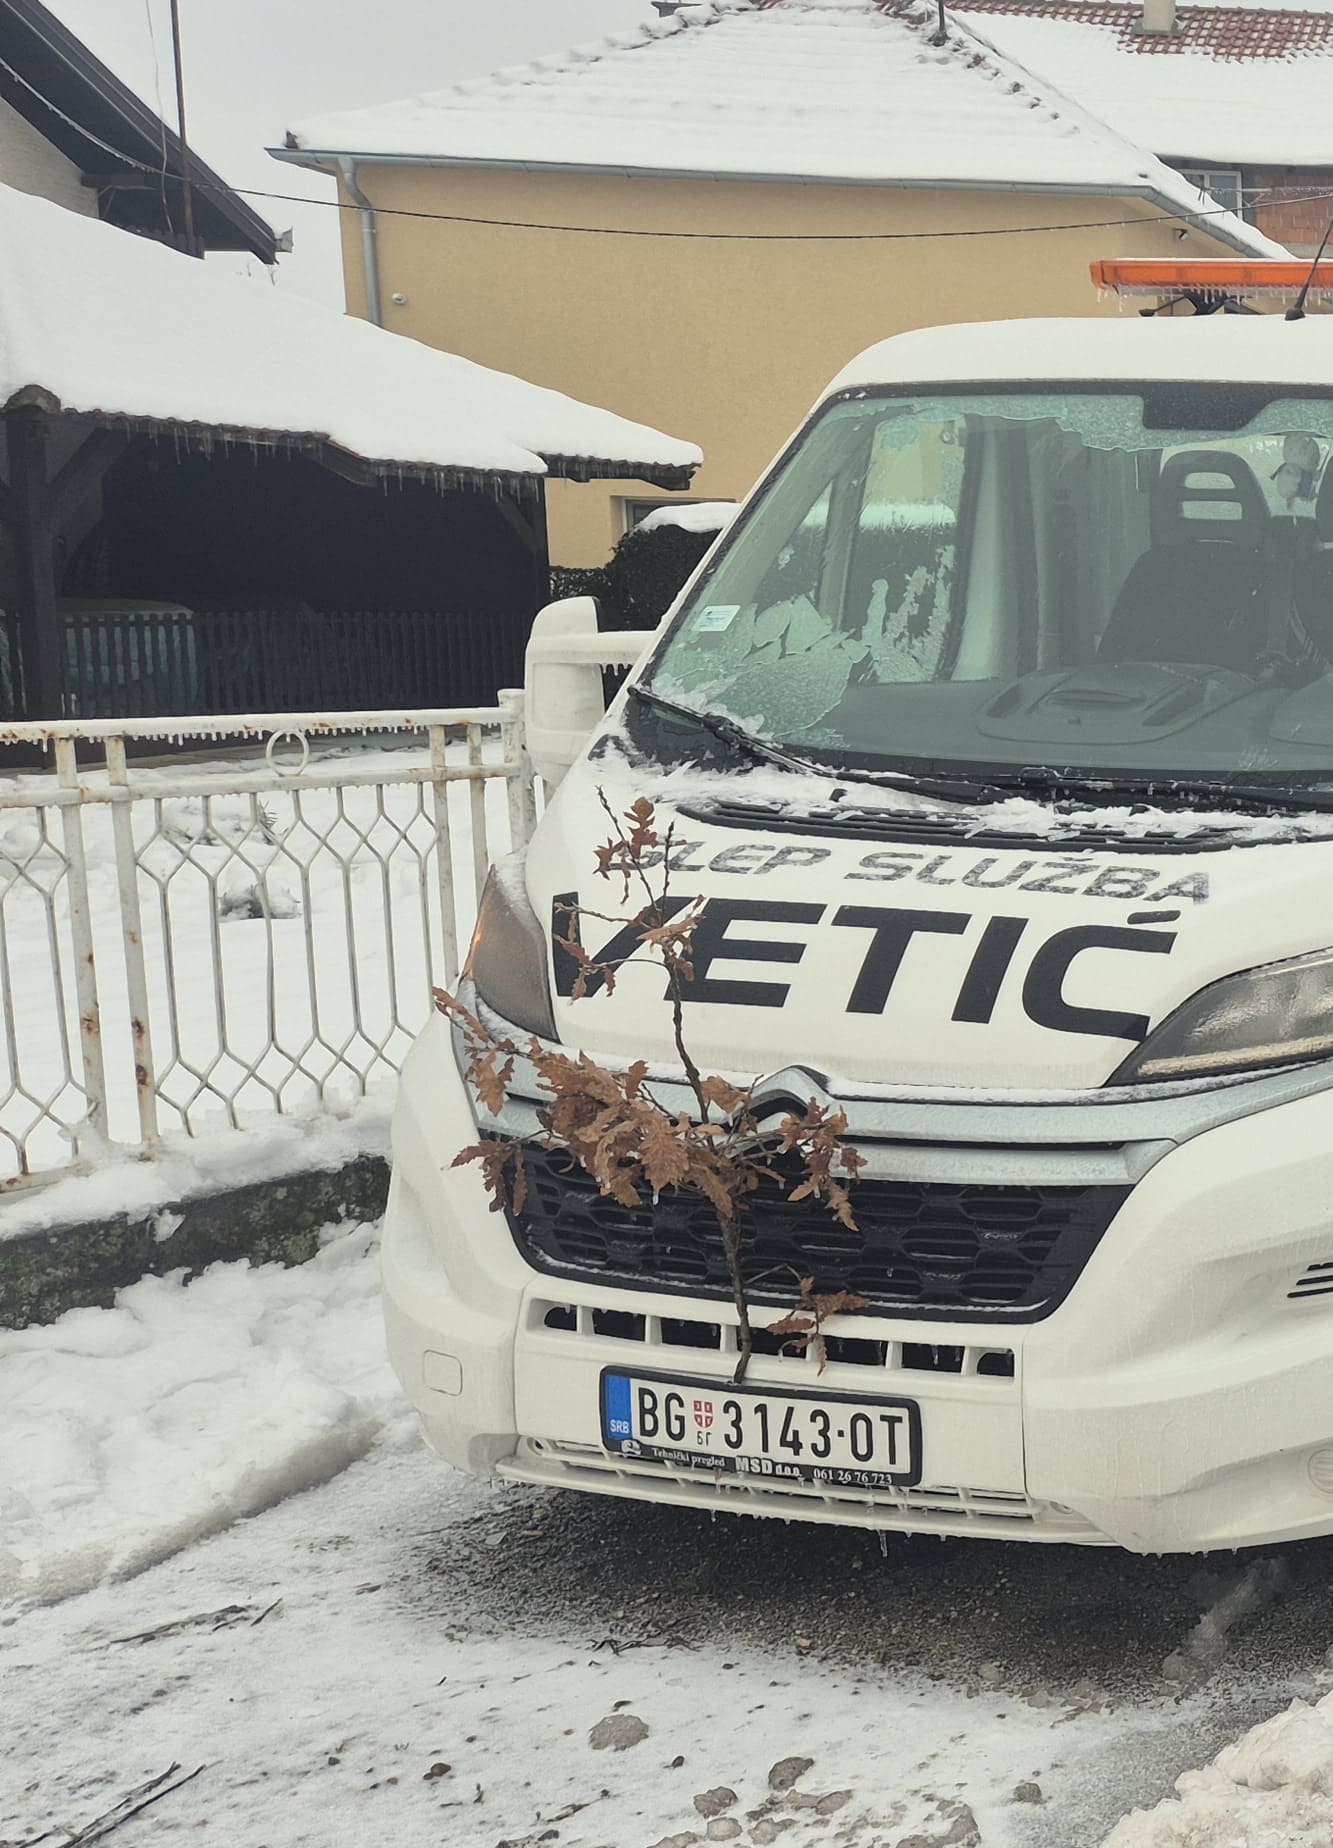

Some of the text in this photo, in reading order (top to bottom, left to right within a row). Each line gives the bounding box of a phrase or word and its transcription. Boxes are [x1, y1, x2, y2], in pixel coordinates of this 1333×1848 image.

[844, 851, 1210, 904] SLUŽBA
[551, 891, 1181, 1042] VETIĆ
[610, 1418, 630, 1434] SRB
[638, 1386, 686, 1441] BG
[691, 1455, 726, 1468] pregled
[735, 1455, 773, 1475] MSD
[813, 1468, 834, 1481] 061
[838, 1470, 852, 1482] 26
[854, 1471, 869, 1484] 76
[871, 1473, 893, 1486] 723
